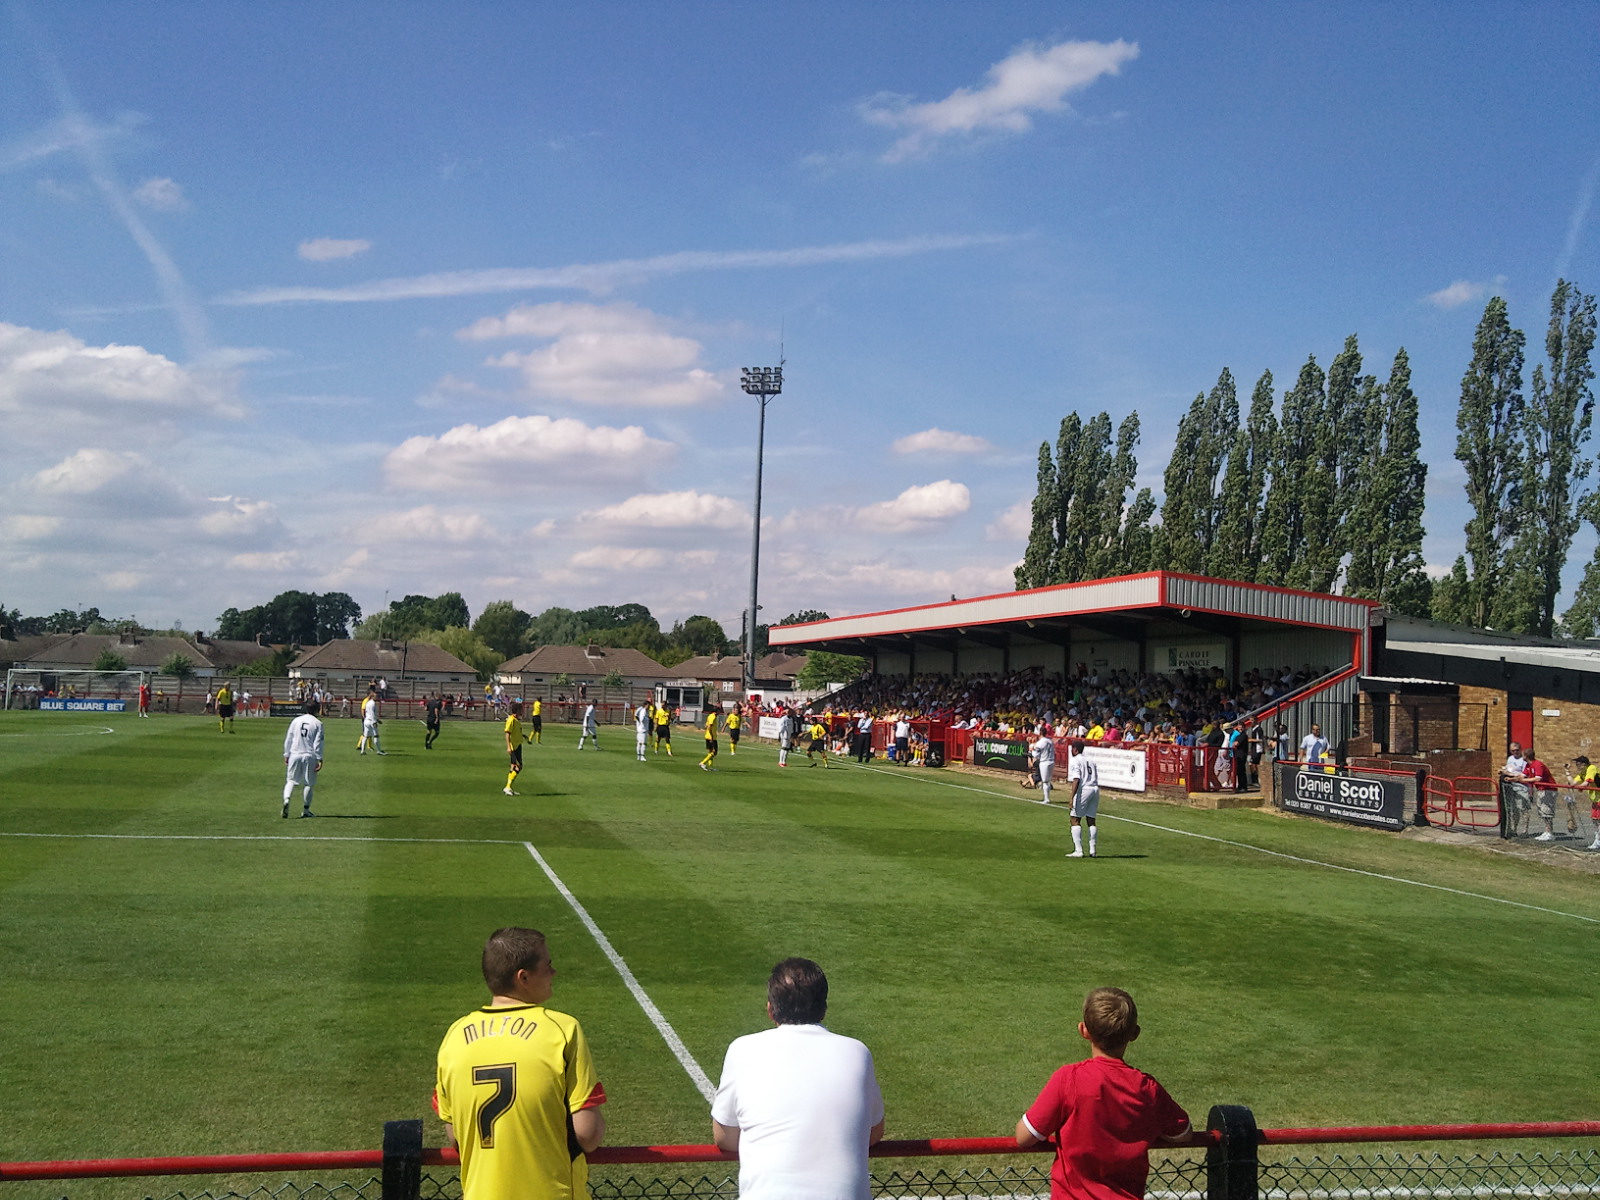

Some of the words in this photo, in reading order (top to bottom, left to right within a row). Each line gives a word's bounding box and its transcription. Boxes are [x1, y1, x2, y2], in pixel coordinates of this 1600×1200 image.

[40, 701, 64, 709] BLUE
[67, 702, 104, 710] SQUARE
[107, 703, 125, 711] BET
[301, 722, 310, 737] 5
[975, 739, 1025, 756] helpucover.co.uk
[1086, 761, 1093, 775] 6
[1298, 774, 1333, 794] Daniel
[1340, 781, 1380, 800] Scott
[1299, 790, 1334, 802] ESTATE
[1340, 795, 1380, 808] AGENTS
[463, 1016, 537, 1045] MILTON
[472, 1062, 516, 1149] 7
